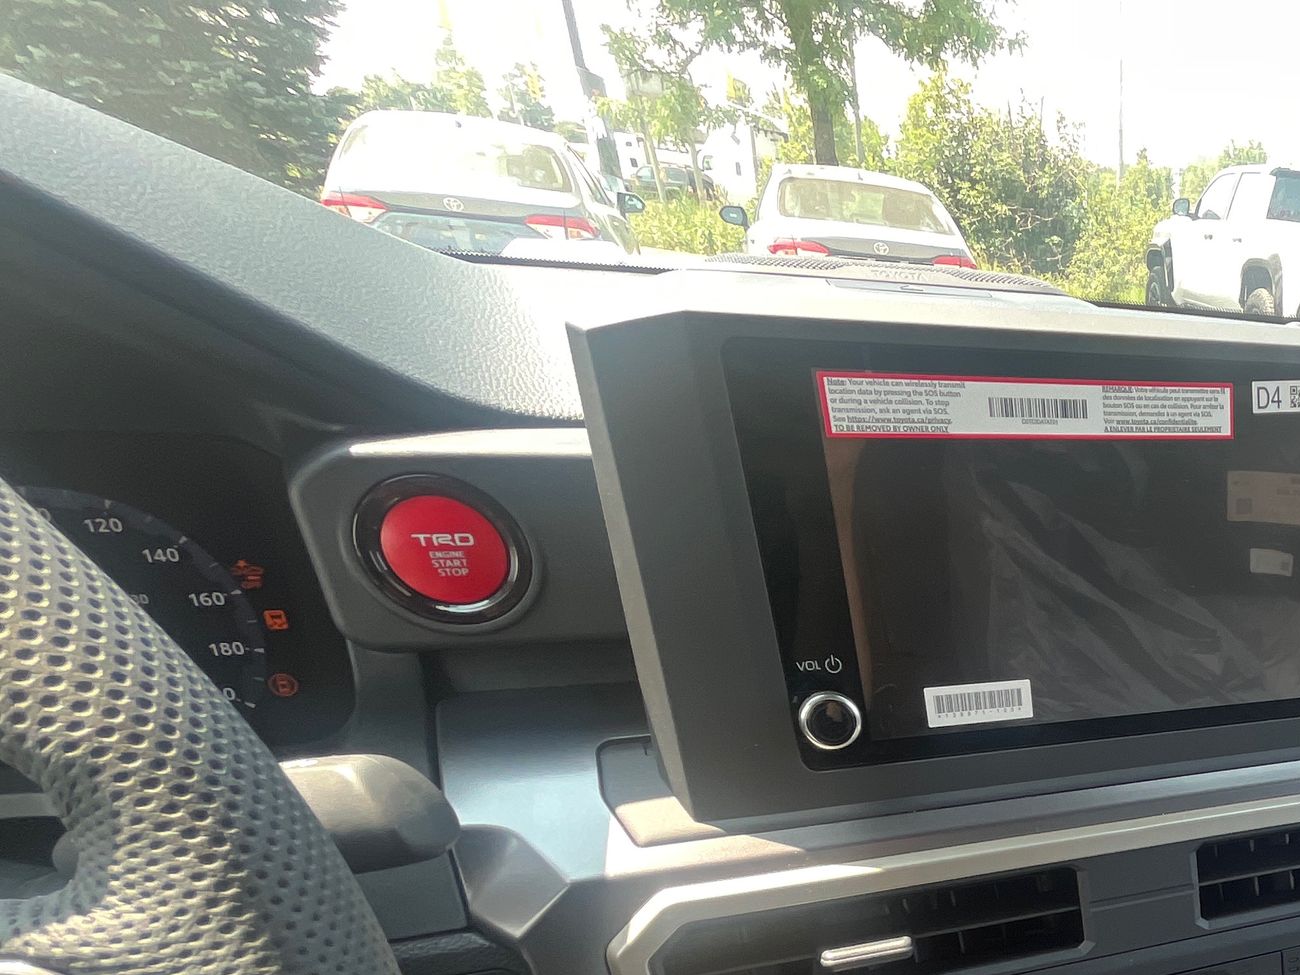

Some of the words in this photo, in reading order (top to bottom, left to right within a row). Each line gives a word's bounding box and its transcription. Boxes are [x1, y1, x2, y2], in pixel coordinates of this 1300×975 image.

[848, 378, 864, 386] Your
[865, 378, 889, 387] vehicle
[829, 387, 856, 395] location
[857, 387, 873, 396] data
[874, 388, 882, 397] by
[924, 389, 938, 397] SOS
[1256, 385, 1282, 409] D4
[869, 397, 893, 405] vehicle
[925, 398, 934, 406] To
[834, 424, 845, 432] TO
[846, 424, 856, 432] BE
[857, 425, 892, 433] REMOVED
[893, 425, 901, 433] BY
[902, 425, 930, 433] OWNER
[83, 516, 123, 534] 120
[410, 532, 475, 547] TRD
[141, 547, 180, 563] 140
[429, 550, 465, 558] ENGINE
[431, 559, 468, 568] START
[437, 567, 470, 577] STOP
[187, 591, 226, 607] 160
[208, 640, 245, 657] 180
[796, 660, 821, 673] VOL
